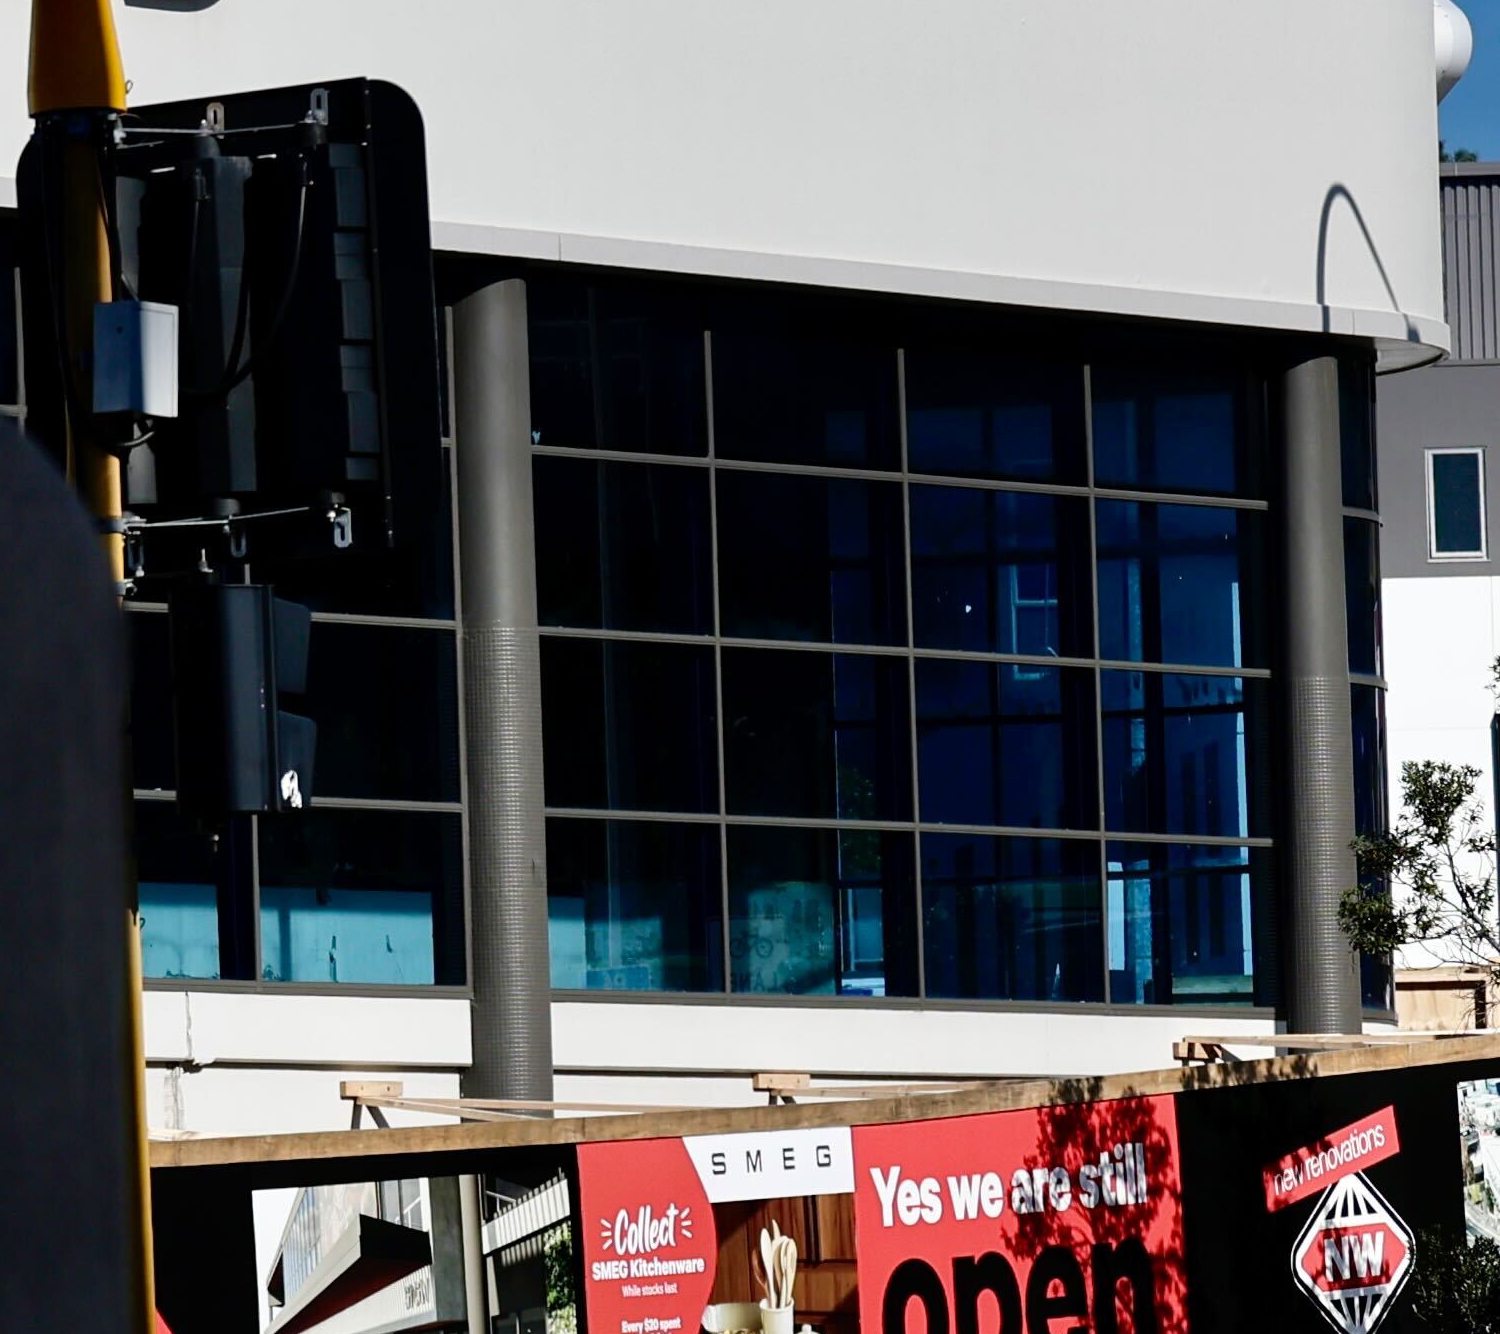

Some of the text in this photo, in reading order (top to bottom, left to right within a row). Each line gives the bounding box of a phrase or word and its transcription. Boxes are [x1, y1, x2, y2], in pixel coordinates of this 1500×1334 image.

[710, 1144, 832, 1176] SMEG
[1273, 1123, 1386, 1197] new renovations
[869, 1142, 1148, 1228] Yes we are still
[614, 1202, 680, 1256] Collect
[592, 1256, 705, 1281] SMEG Kitchenware
[1323, 1230, 1386, 1282] NW
[621, 1284, 642, 1297] While
[664, 1281, 678, 1294] last
[621, 1319, 644, 1334] Every
[660, 1317, 682, 1332] spent
